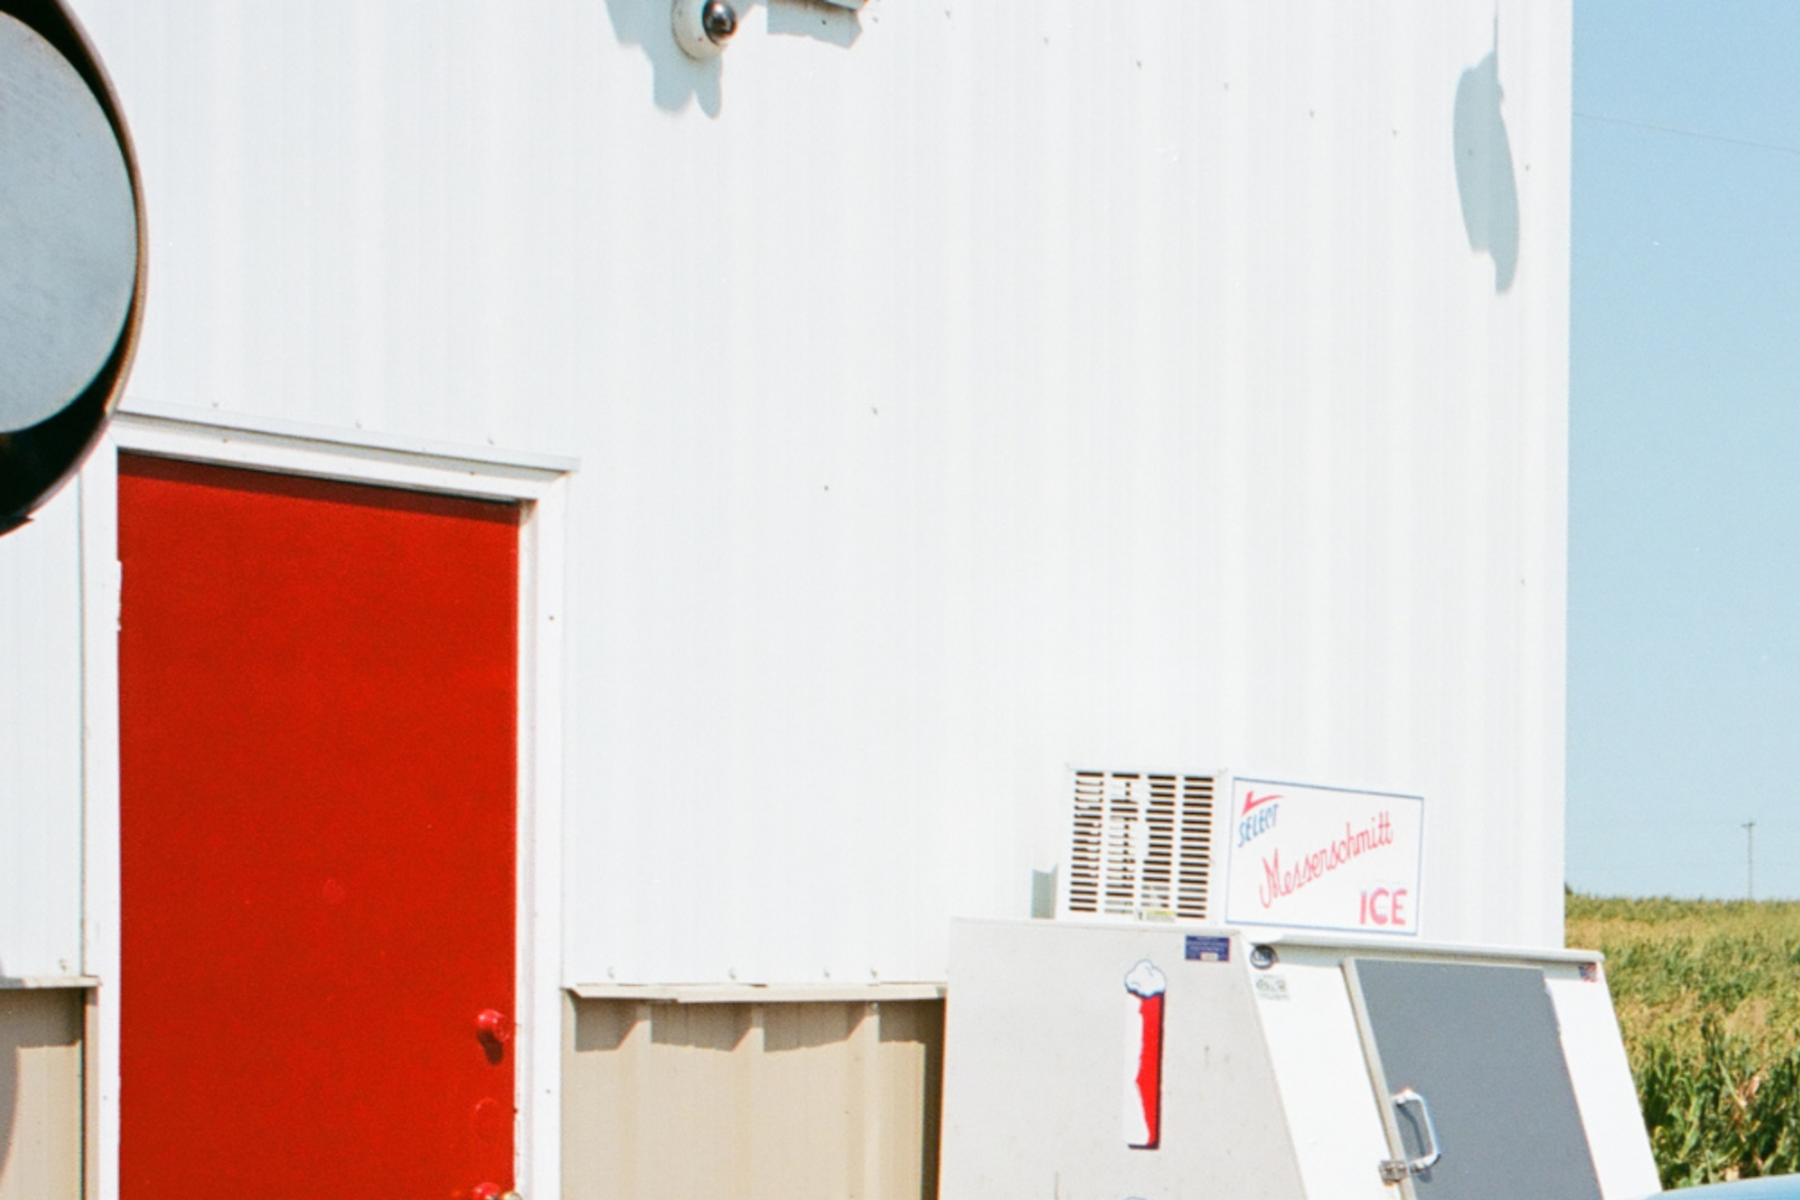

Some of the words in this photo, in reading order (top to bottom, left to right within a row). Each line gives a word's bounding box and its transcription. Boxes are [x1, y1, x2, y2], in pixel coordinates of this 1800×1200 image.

[1237, 803, 1279, 848] SELECT
[1258, 810, 1394, 909] Messerschmitt
[1359, 886, 1408, 926] ICE
